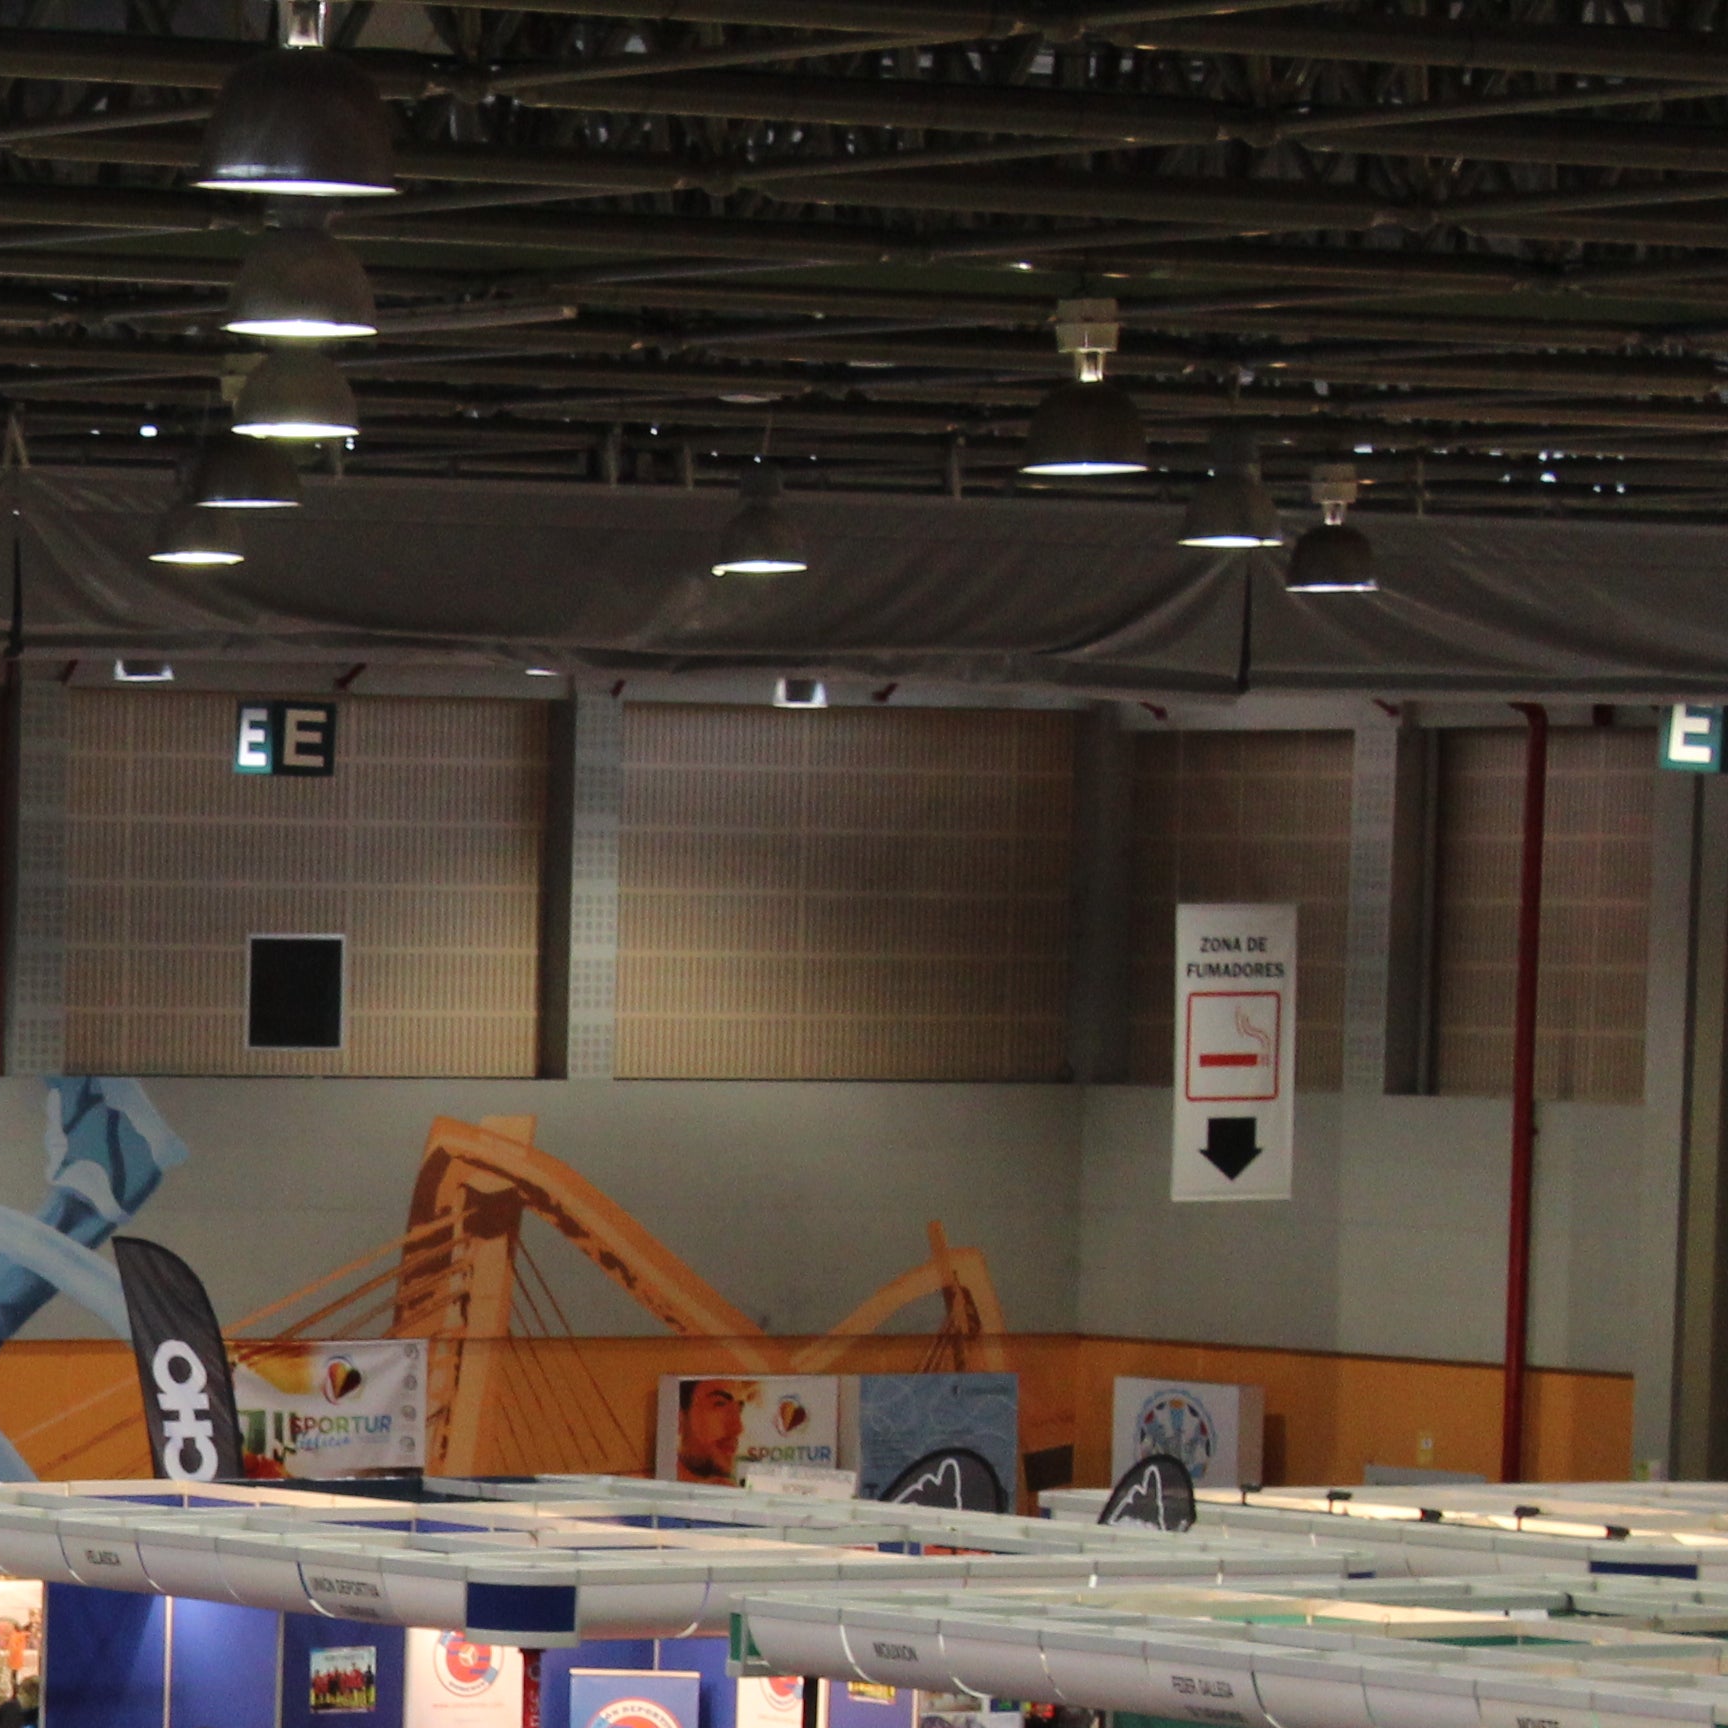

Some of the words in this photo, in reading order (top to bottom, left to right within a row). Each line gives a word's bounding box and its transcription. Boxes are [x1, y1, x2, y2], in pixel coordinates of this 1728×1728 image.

[238, 708, 268, 768] E
[283, 709, 327, 767] E
[1200, 937, 1242, 952] ZONA
[1247, 937, 1268, 952] DE
[1187, 962, 1284, 978] FUMADORES
[293, 1415, 392, 1435] SPORTUR
[746, 1446, 832, 1461] SPORTUR
